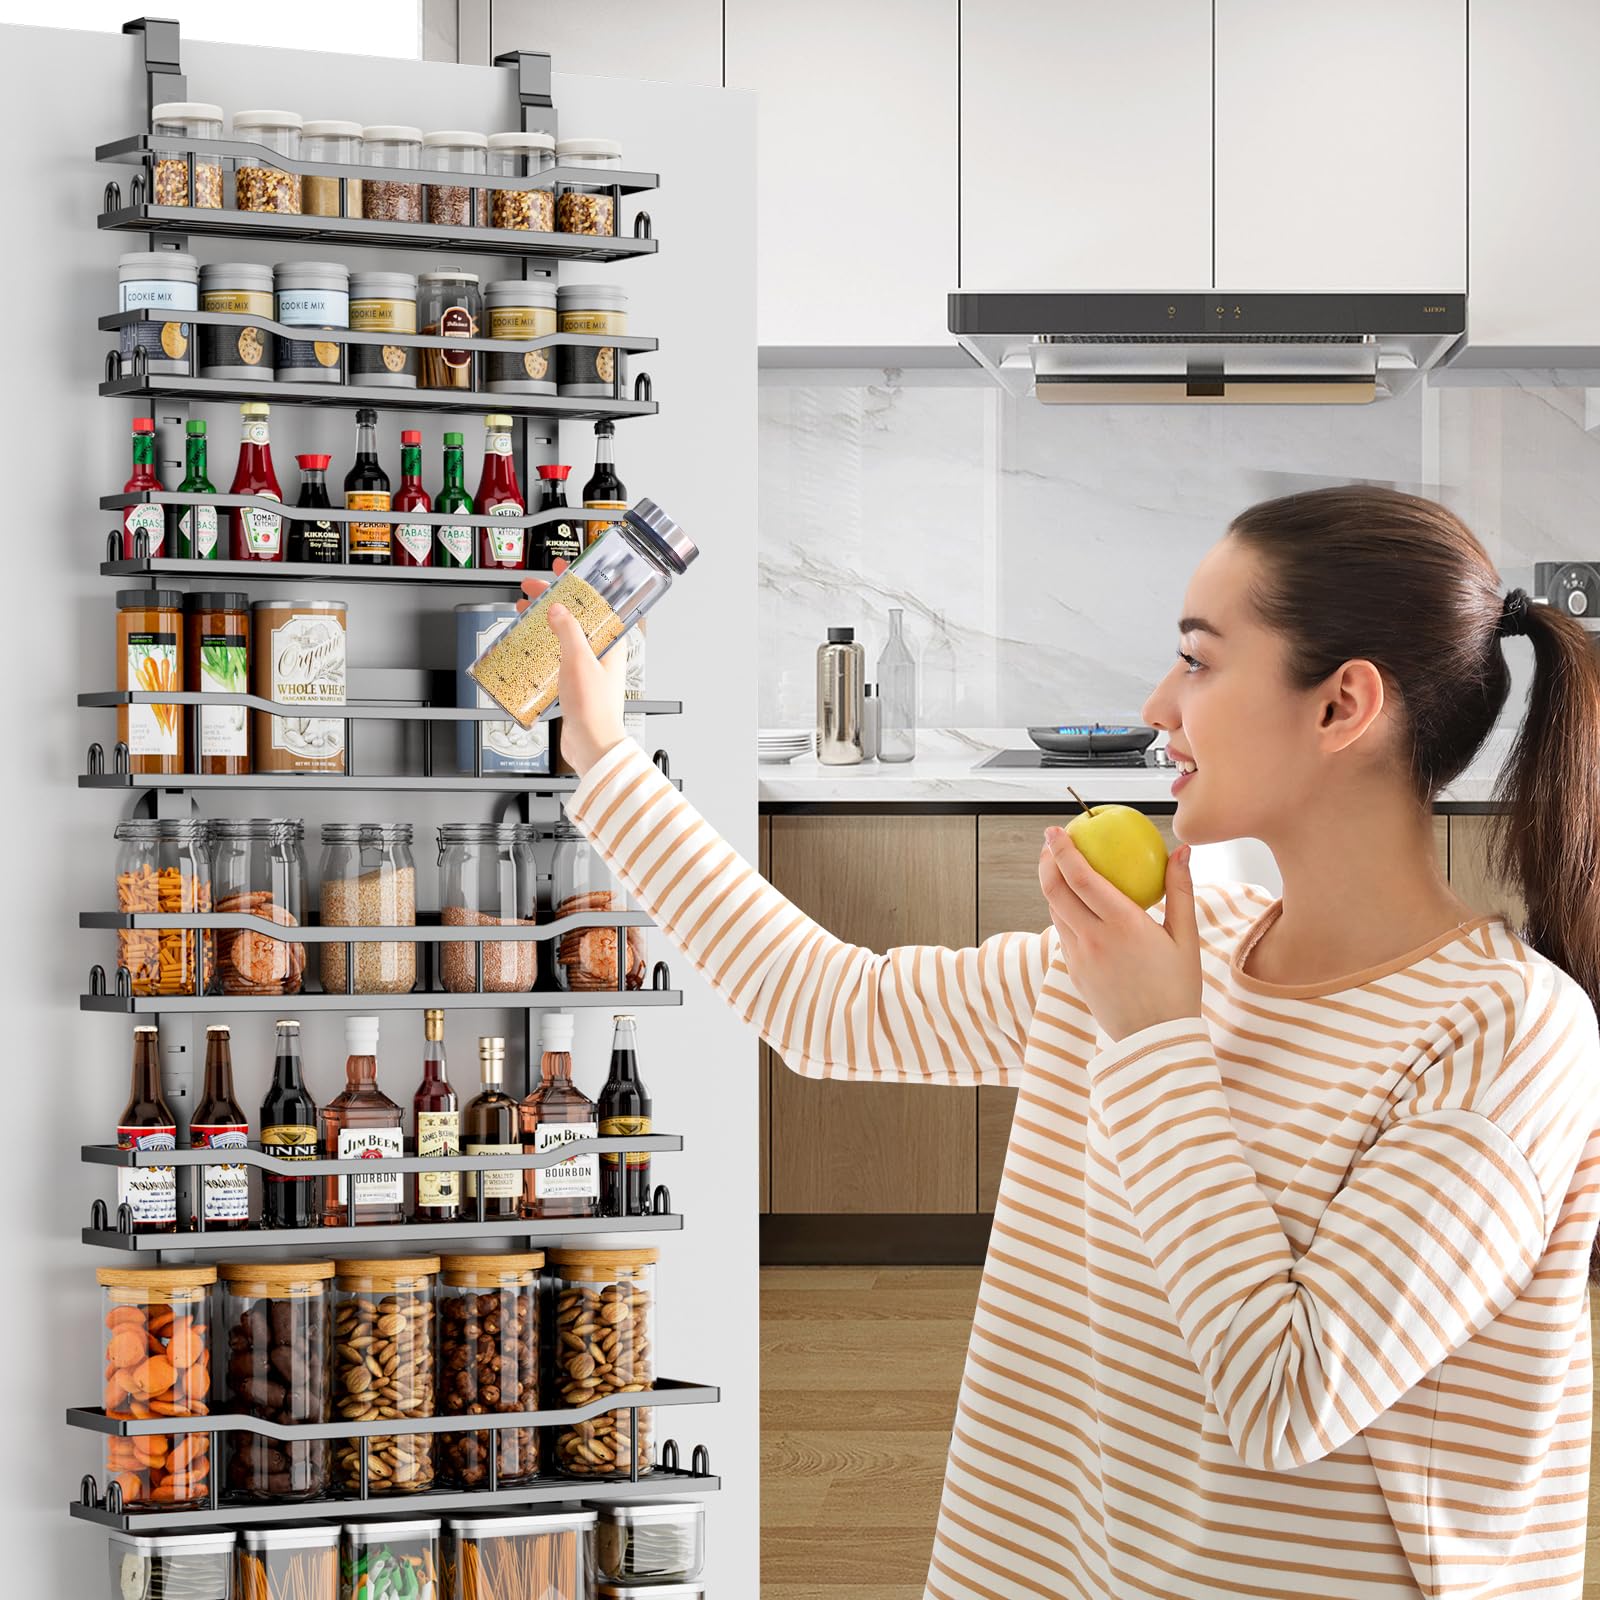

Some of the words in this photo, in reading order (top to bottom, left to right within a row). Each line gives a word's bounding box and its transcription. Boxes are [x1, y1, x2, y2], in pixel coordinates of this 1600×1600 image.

[128, 292, 155, 301] COOKIE
[158, 293, 172, 301] MIX
[207, 301, 232, 310] COOKIE
[234, 302, 249, 310] MIX
[281, 301, 308, 310] COOKIE
[311, 302, 325, 310] MIX
[351, 309, 376, 318] COOKIE
[379, 310, 392, 318] MIX
[493, 318, 518, 327] COOKIE
[521, 319, 535, 327] MIX
[565, 321, 590, 330] COOKIE
[592, 321, 607, 329] MIX
[277, 684, 317, 695] WHOLE
[319, 684, 345, 696] WHEAT
[344, 1138, 366, 1155] JIM
[368, 1134, 400, 1152] BEEM
[540, 1132, 562, 1149] JIM
[545, 1167, 592, 1178] BOURBON
[355, 1173, 397, 1183] OURBON
